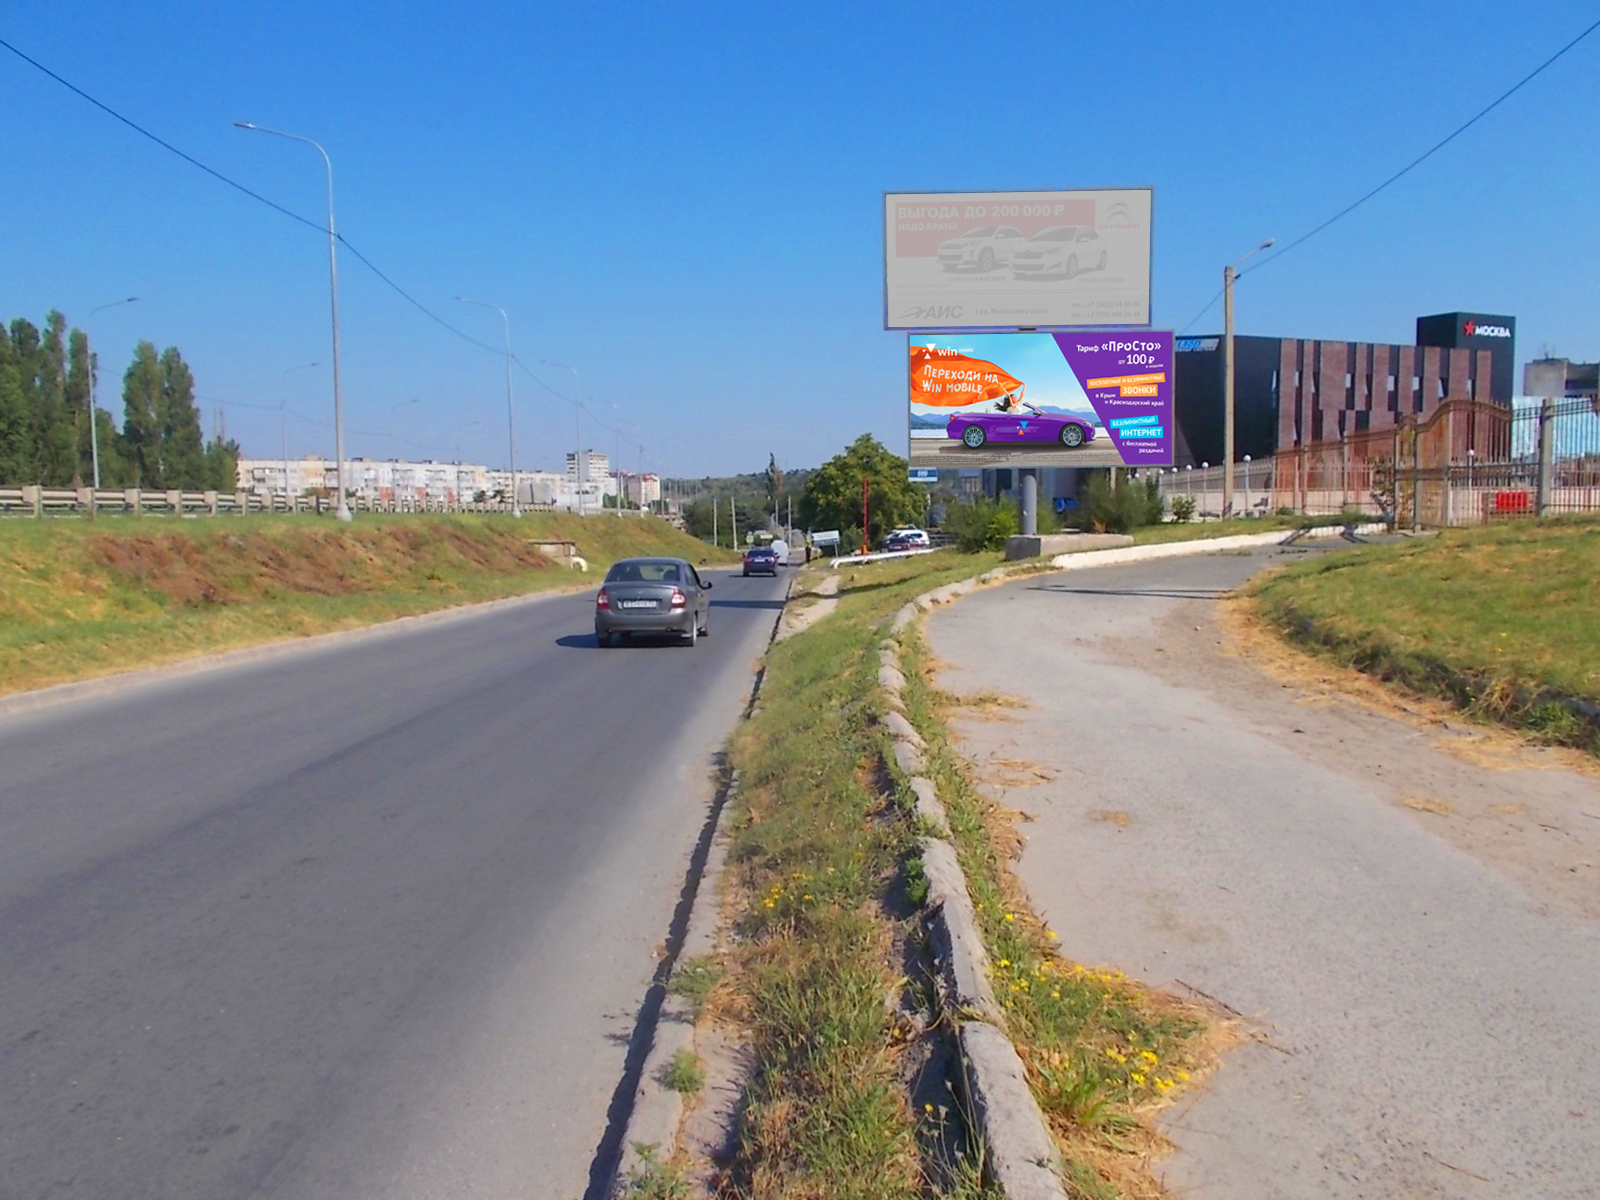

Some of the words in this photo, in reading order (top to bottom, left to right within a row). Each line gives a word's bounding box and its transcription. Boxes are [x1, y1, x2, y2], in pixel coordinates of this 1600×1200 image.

[897, 206, 960, 220] ВЫГОДА
[963, 205, 987, 219] ДО
[990, 205, 1019, 217] 200
[1022, 204, 1051, 217] 000
[898, 223, 925, 232] НАДО
[926, 222, 958, 231] БРАТЬ!
[923, 305, 964, 319] АИС
[1475, 325, 1511, 338] МОСКВА
[937, 346, 958, 356] win
[1076, 344, 1099, 353] Тариф
[1126, 353, 1147, 365] 100
[1122, 386, 1156, 394] ЗВОНКИ
[1121, 428, 1162, 437] ИНТЕРНЕТ
